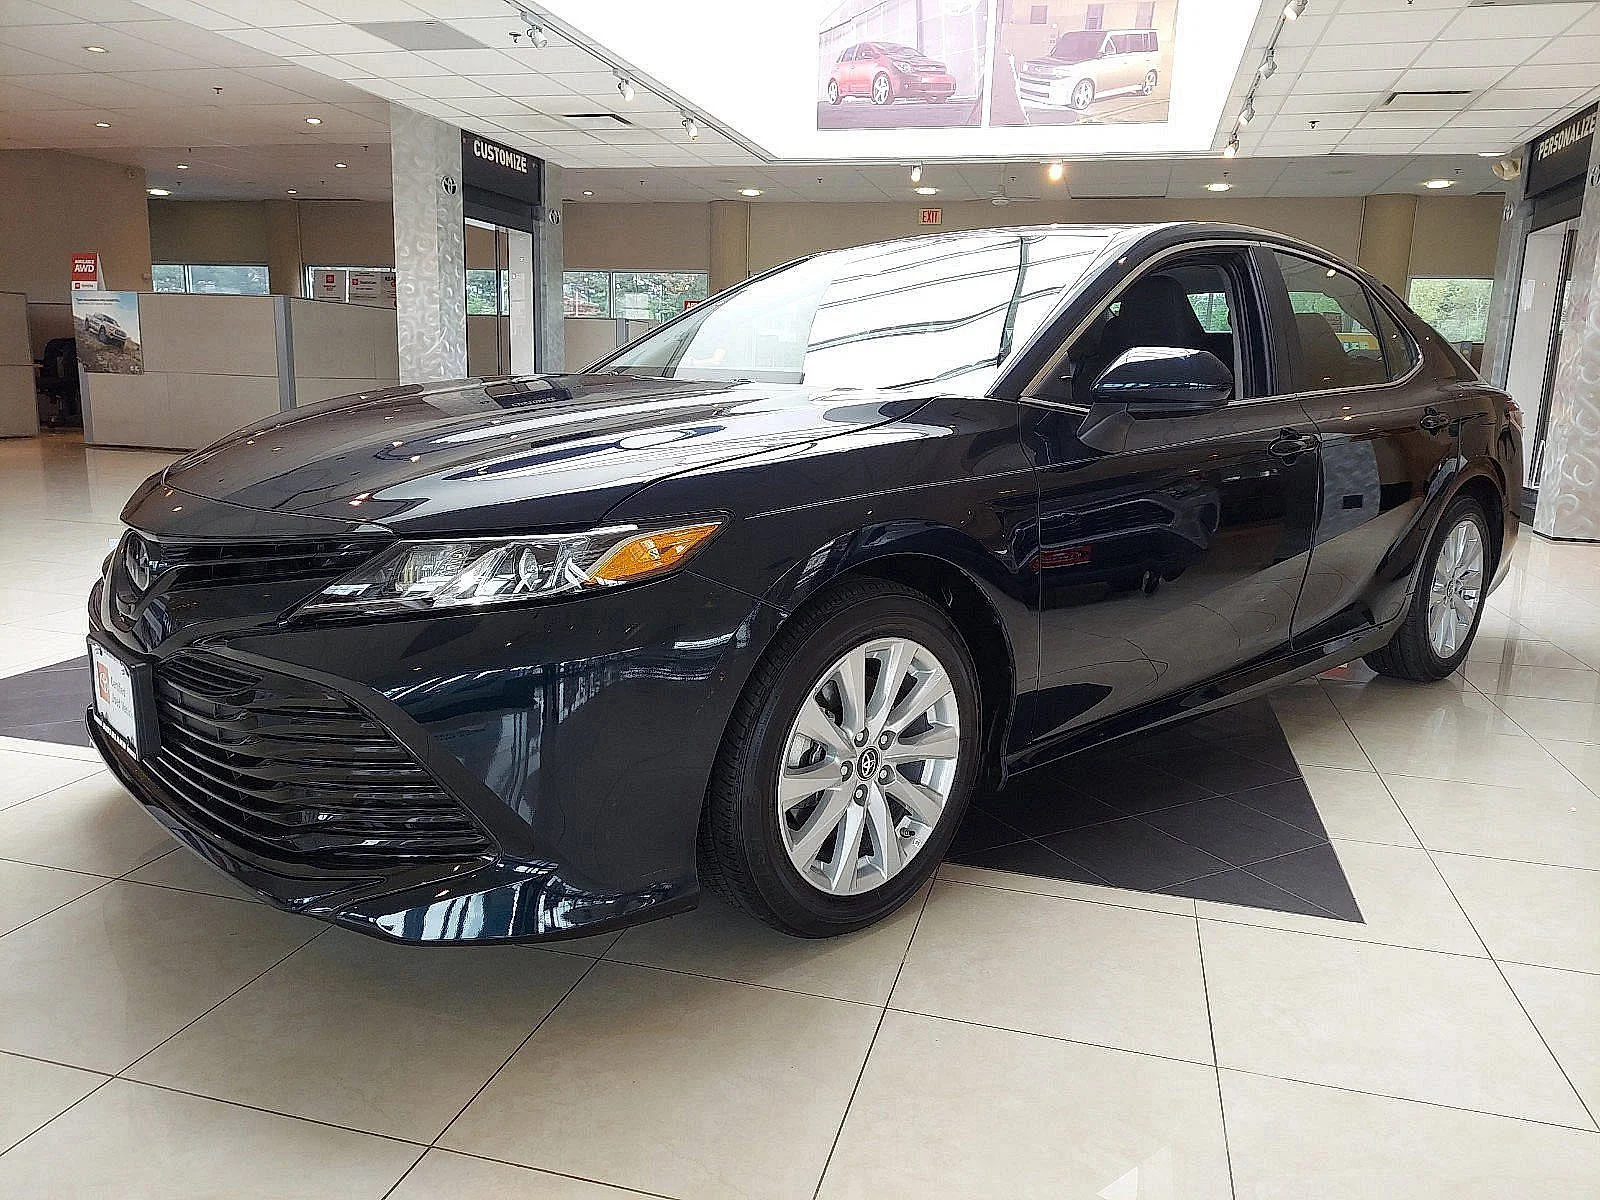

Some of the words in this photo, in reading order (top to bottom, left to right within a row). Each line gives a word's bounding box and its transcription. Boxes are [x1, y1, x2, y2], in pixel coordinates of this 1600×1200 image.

[1538, 114, 1597, 161] PERSONALIZE
[473, 139, 527, 173] CUSTOMIZE
[921, 210, 939, 223] EXIT
[74, 264, 95, 273] AWD
